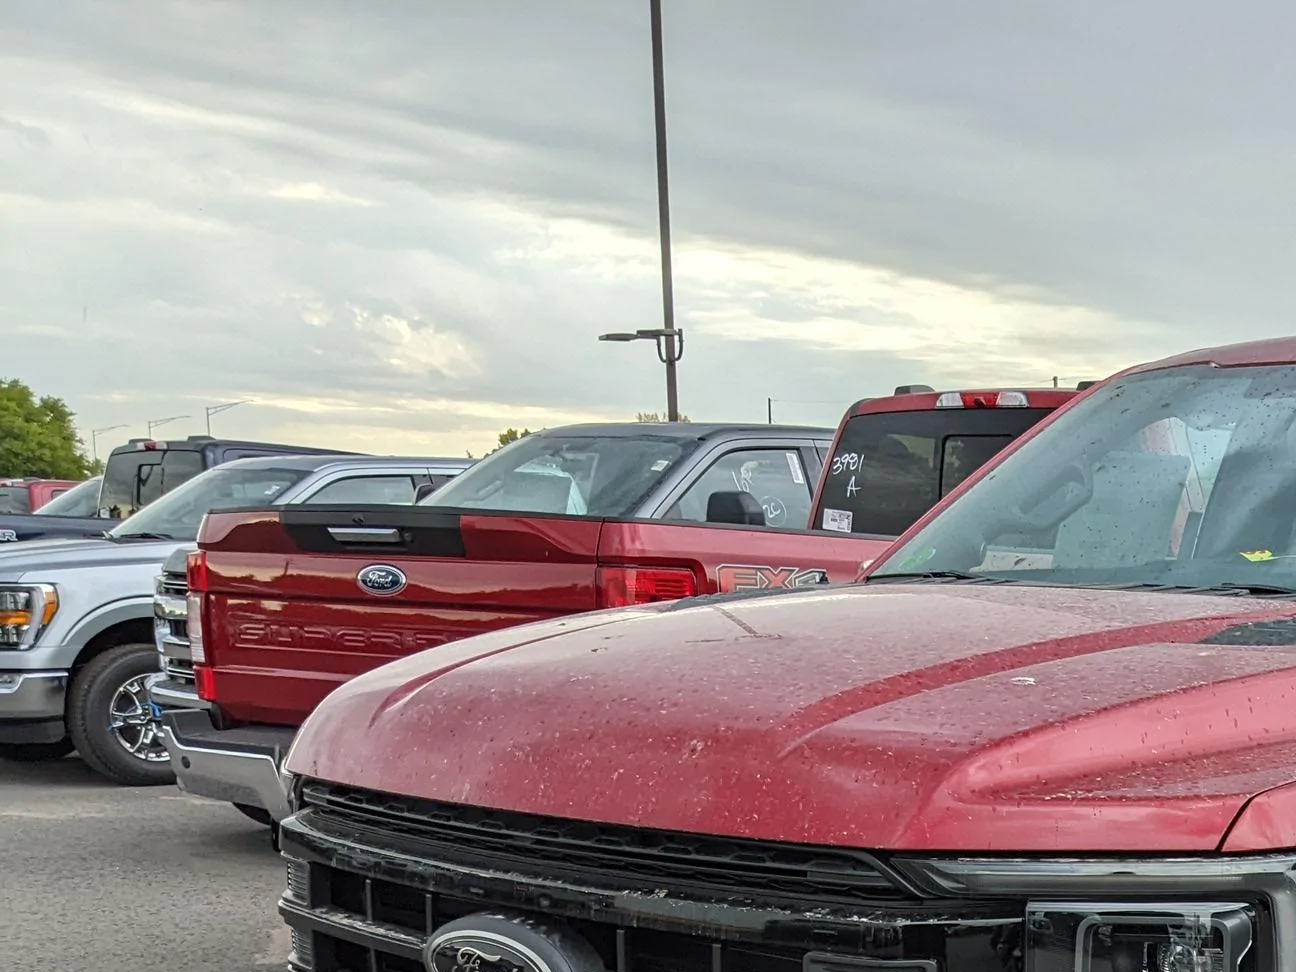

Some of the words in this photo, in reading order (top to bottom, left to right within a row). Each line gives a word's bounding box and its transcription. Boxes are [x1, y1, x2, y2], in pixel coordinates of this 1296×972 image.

[832, 452, 864, 475] 3981
[846, 475, 861, 497] A
[367, 571, 393, 587] Ford
[716, 563, 827, 592] FX4
